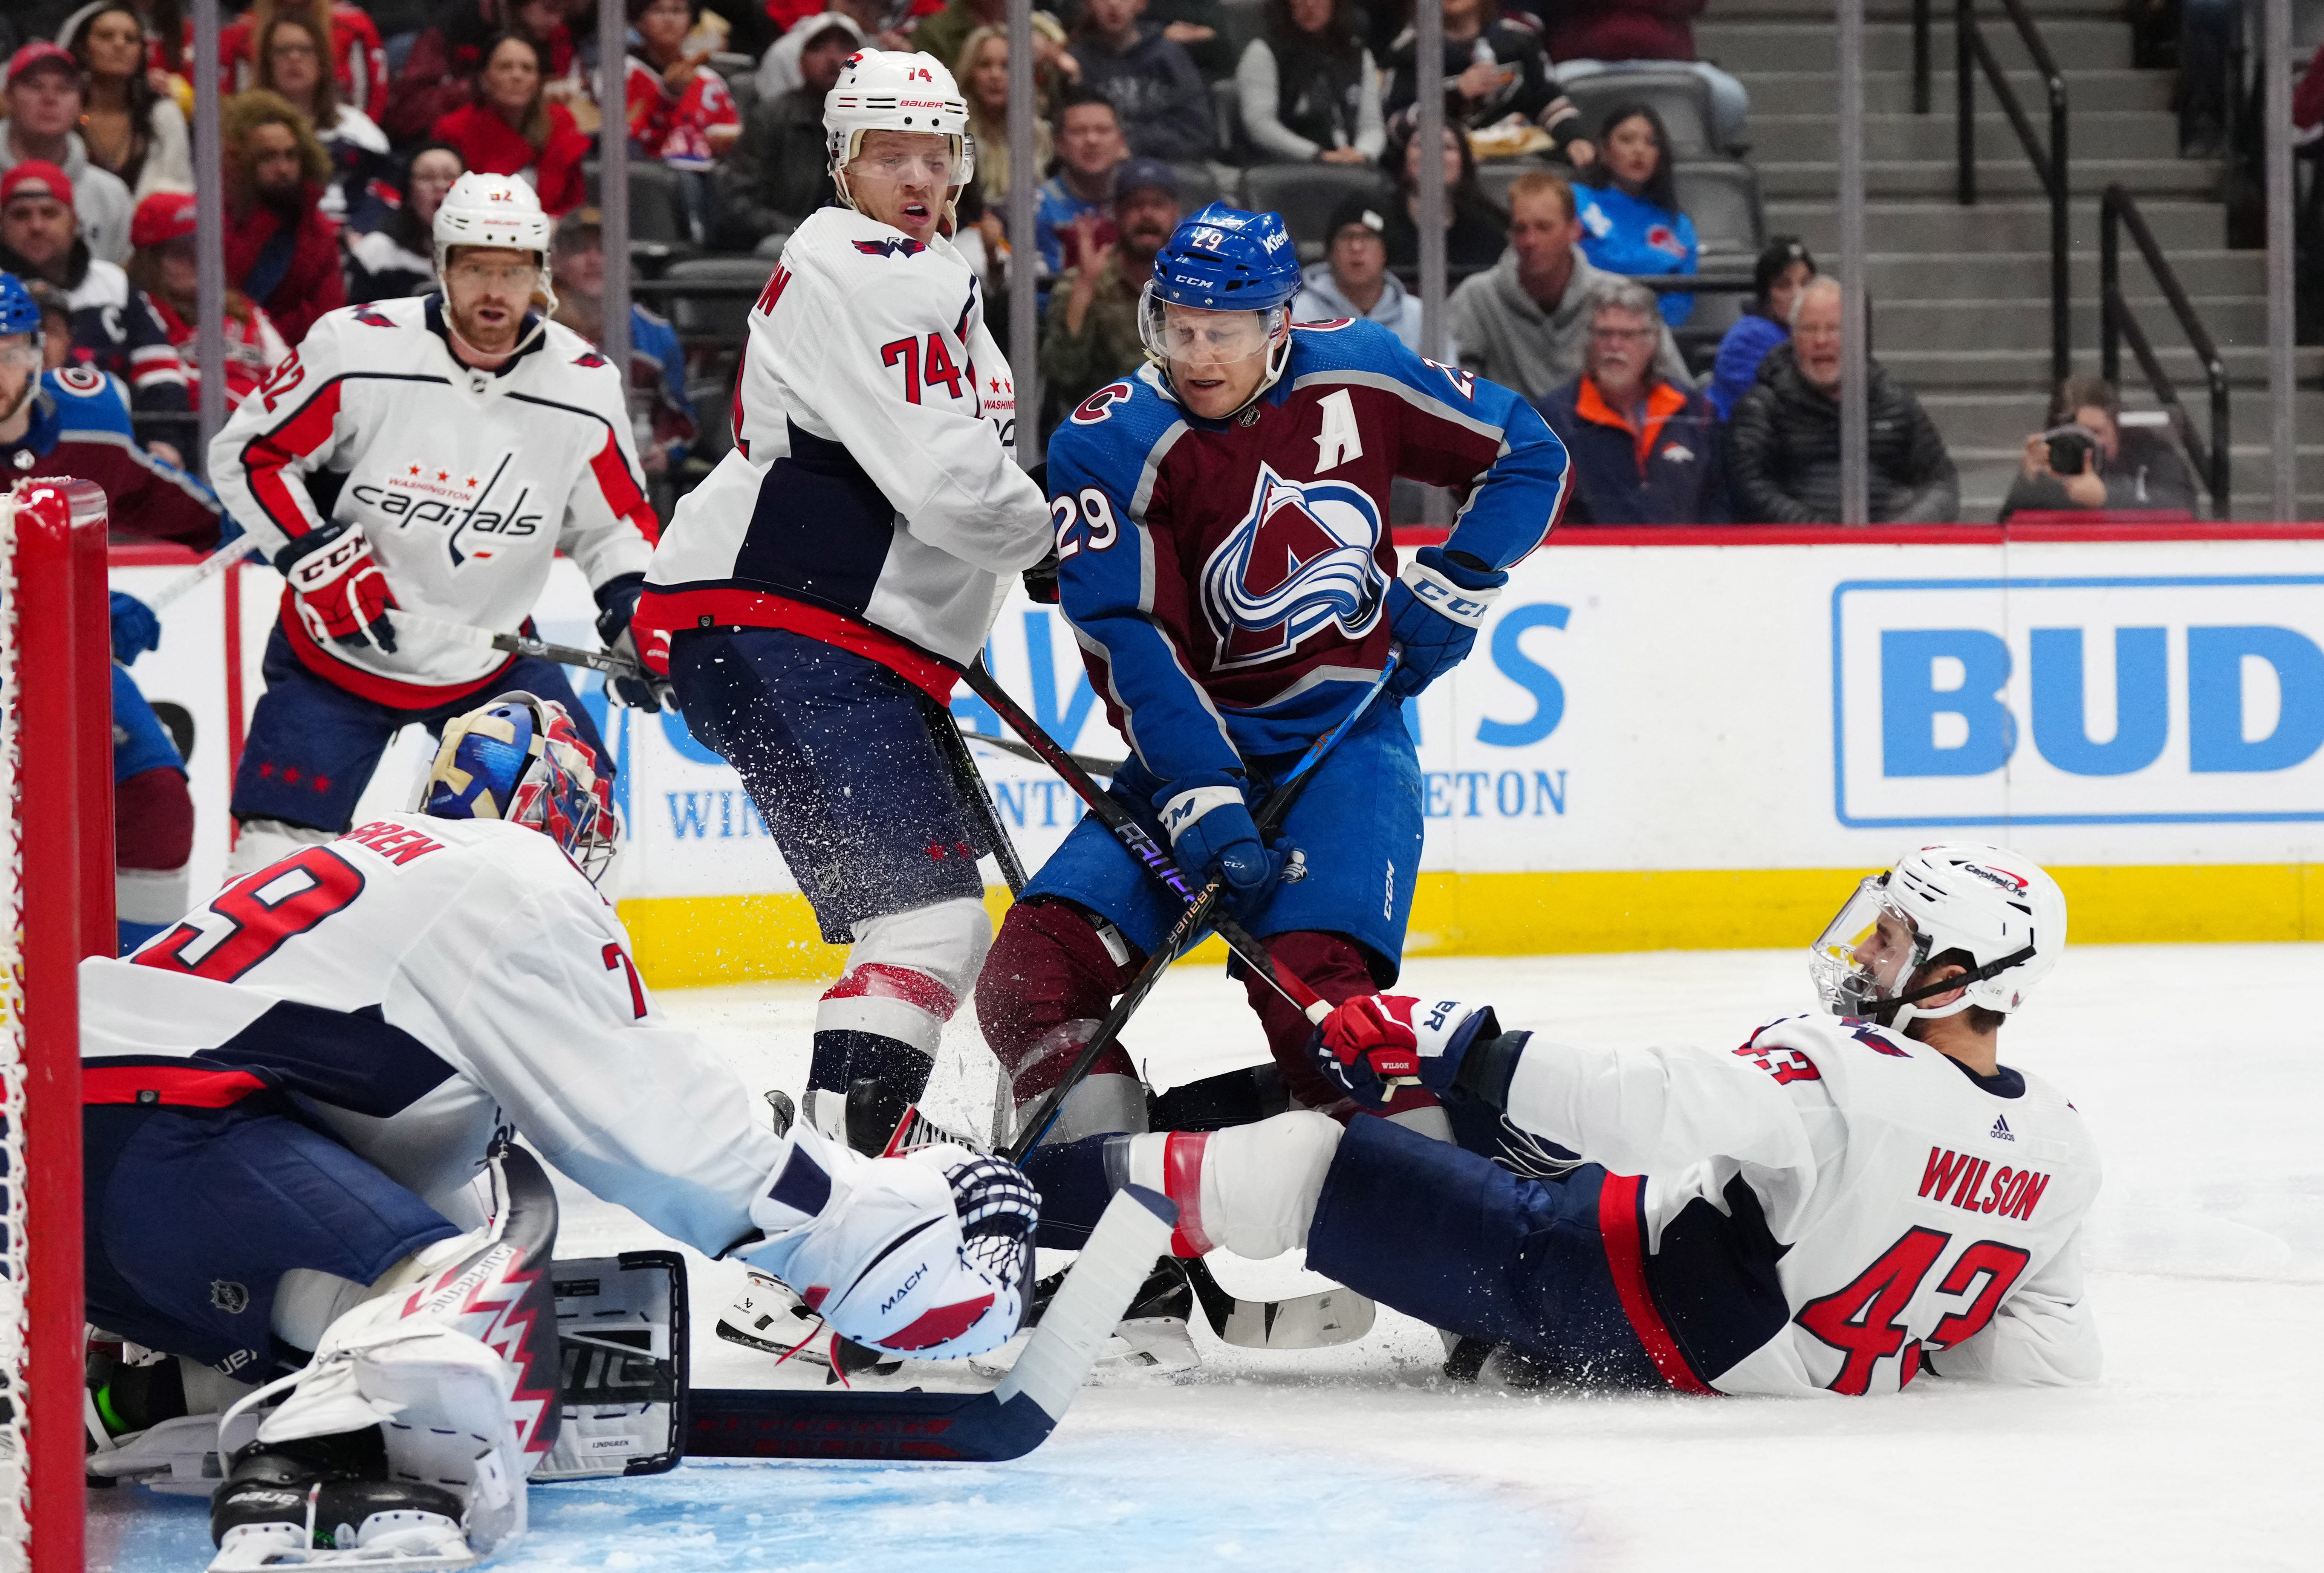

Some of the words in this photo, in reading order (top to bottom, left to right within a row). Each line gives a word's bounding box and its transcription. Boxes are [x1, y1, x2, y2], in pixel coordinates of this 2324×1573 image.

[903, 67, 932, 82] 74
[1191, 231, 1224, 250] 29
[1175, 275, 1214, 288] CCM
[259, 347, 305, 413] 92
[881, 333, 962, 405] 74
[1421, 356, 1477, 402] 2
[1314, 388, 1363, 474] A
[352, 453, 543, 566] capitals
[389, 477, 472, 501] WASHINGTON
[1051, 486, 1119, 562] 29
[1881, 625, 2324, 777] BUD
[130, 846, 365, 984] 9
[1167, 891, 1208, 944] BAUER
[1384, 859, 1395, 921] CCM
[1990, 1130, 2015, 1141] adidas
[1917, 1146, 2050, 1221] WILSON
[881, 1263, 928, 1315] MACH
[1792, 1225, 2031, 1396] 43
